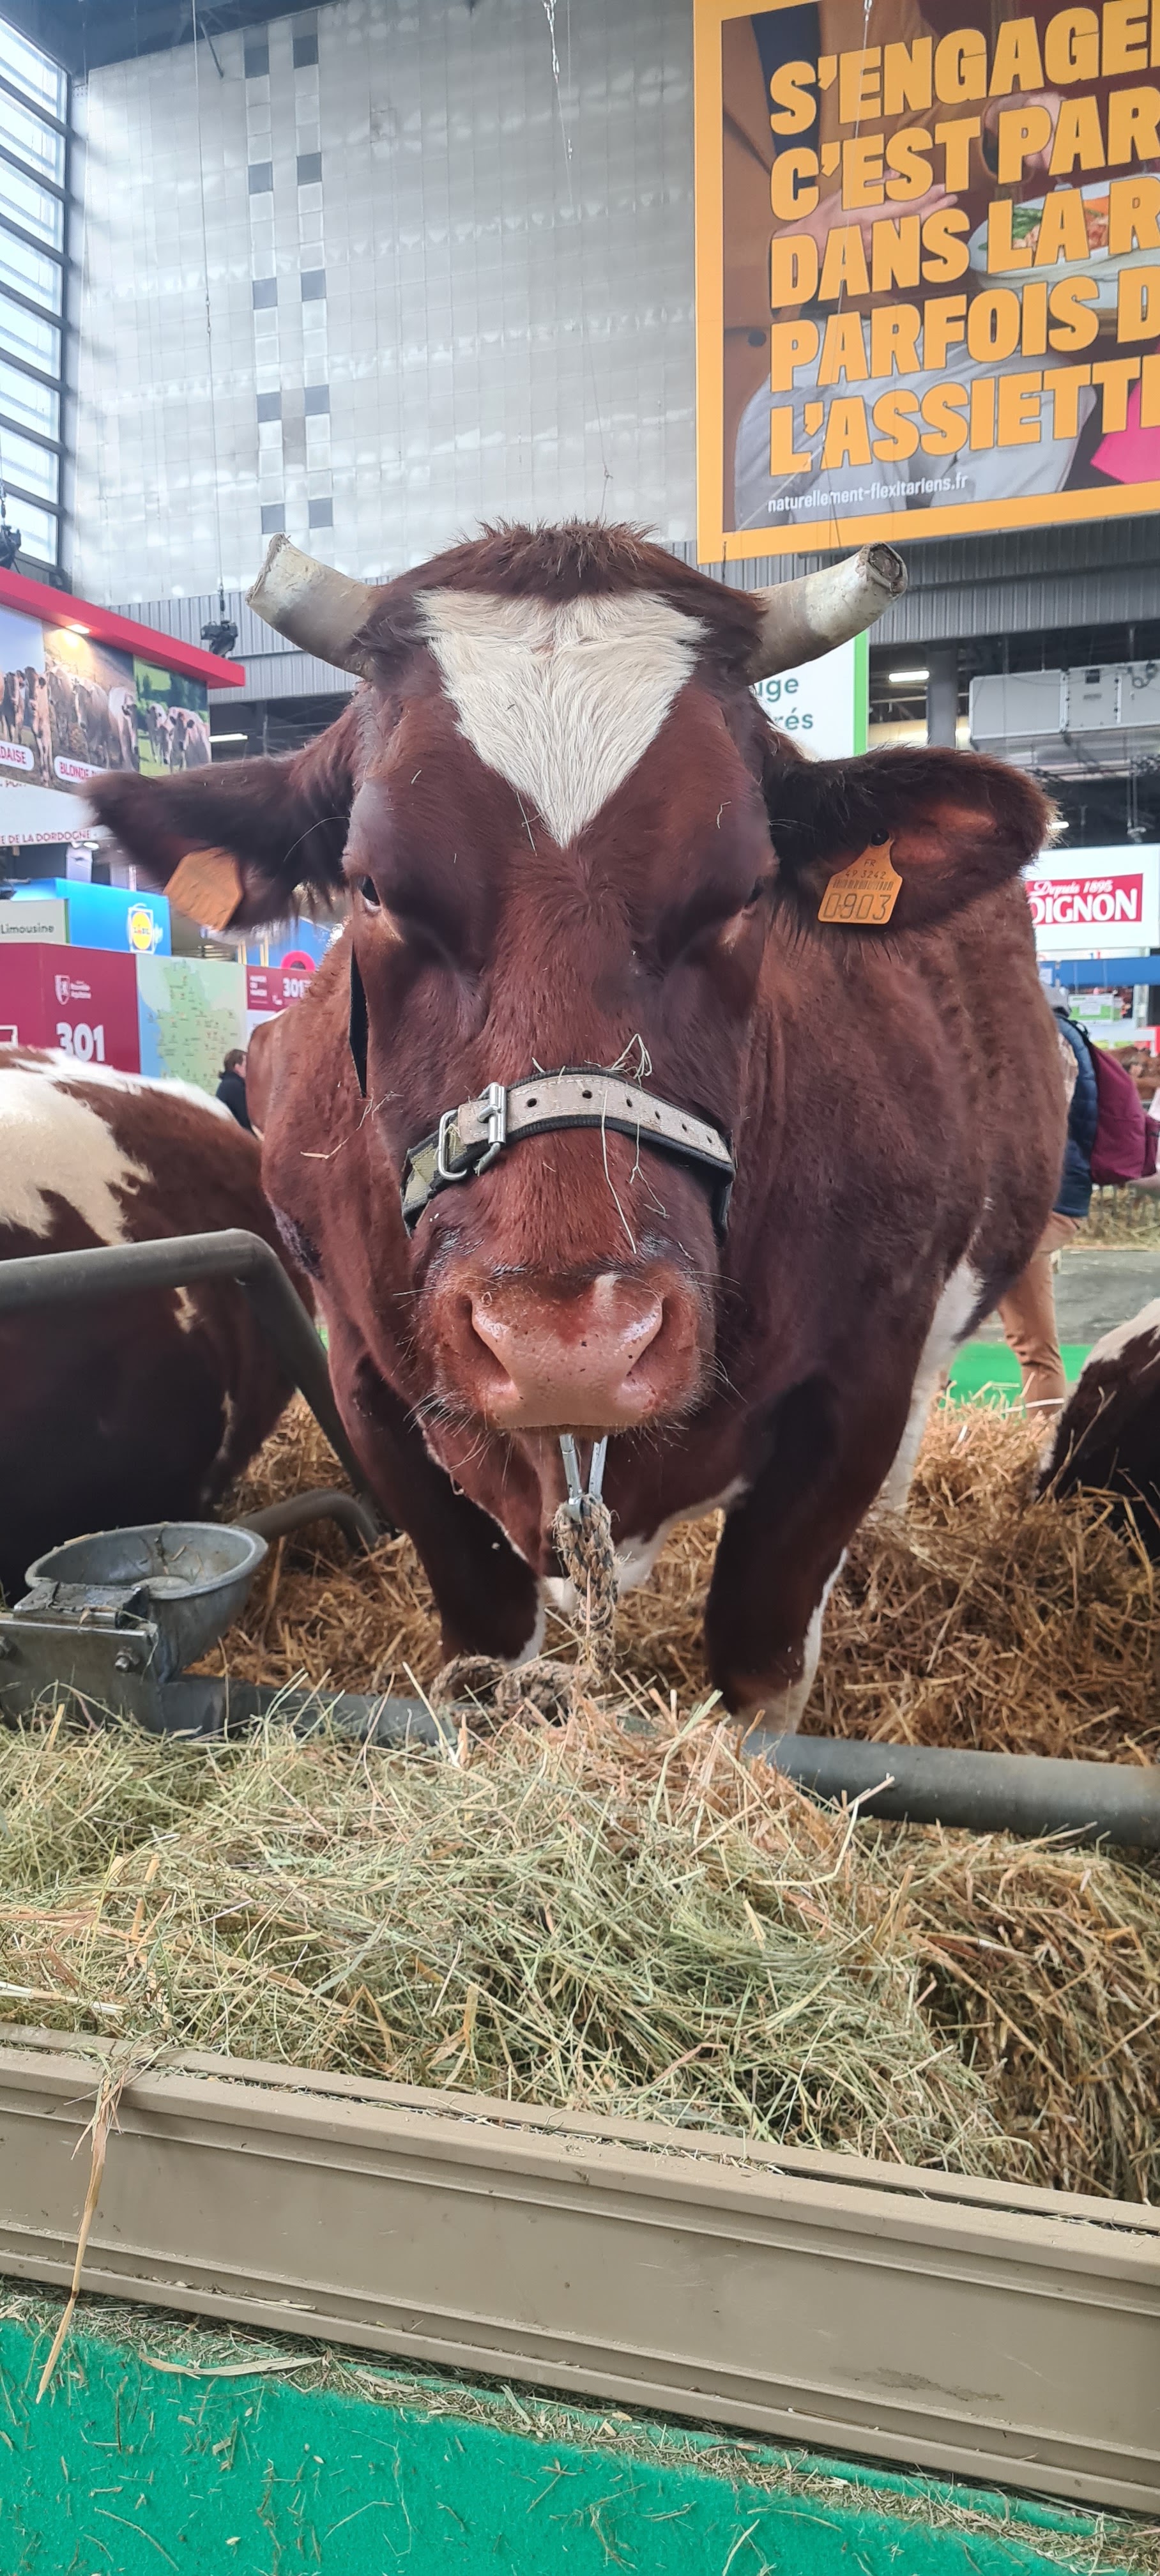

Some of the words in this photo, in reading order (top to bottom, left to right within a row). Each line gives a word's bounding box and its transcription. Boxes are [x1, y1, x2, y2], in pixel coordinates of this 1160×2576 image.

[770, 0, 1160, 135] S'ENGAGE
[770, 117, 982, 222] C'EST
[770, 208, 970, 309] DANS
[986, 188, 1091, 275] LA
[770, 275, 1101, 393] PARFOIS
[767, 472, 969, 513] naturellement-flexitariens.fr
[8, 834, 19, 844] DE
[22, 833, 34, 843] LA
[36, 830, 90, 842] DORDOGNE
[864, 859, 876, 867] FR
[823, 893, 892, 921] 0903
[1, 923, 55, 935] Limousine
[56, 1022, 105, 1062] 301
